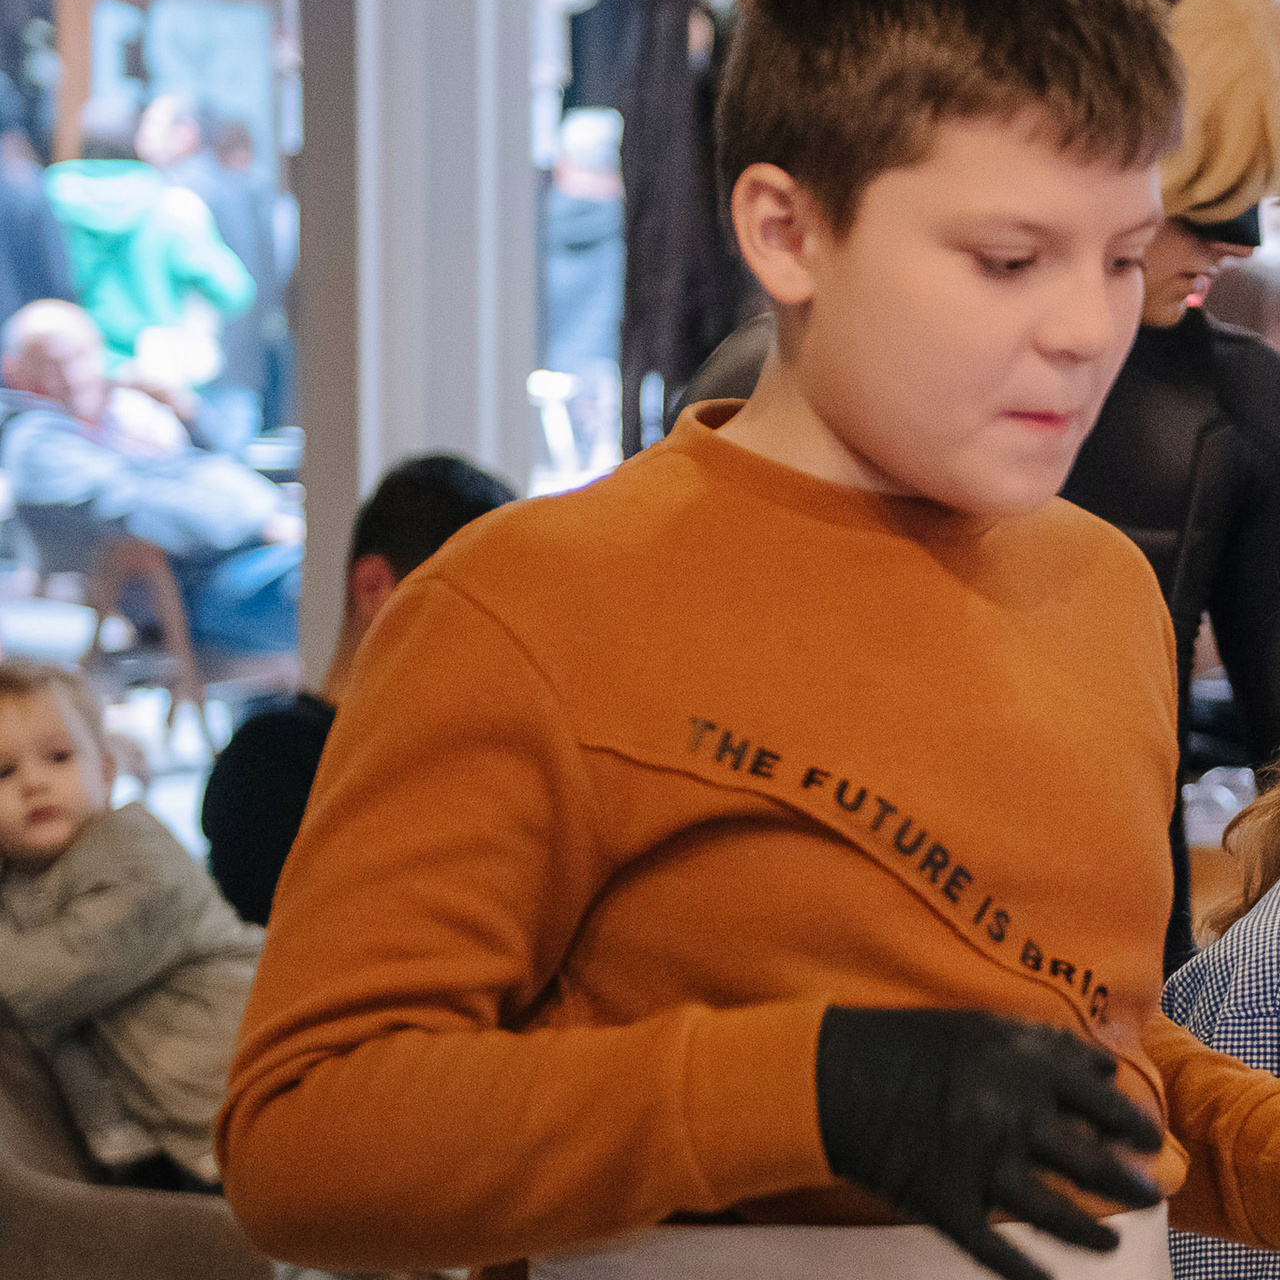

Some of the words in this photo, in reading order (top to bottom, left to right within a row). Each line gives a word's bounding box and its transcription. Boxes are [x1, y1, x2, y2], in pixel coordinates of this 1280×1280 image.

[689, 716, 782, 780] THE
[801, 766, 974, 904] FUTURE
[973, 895, 1012, 945] IS
